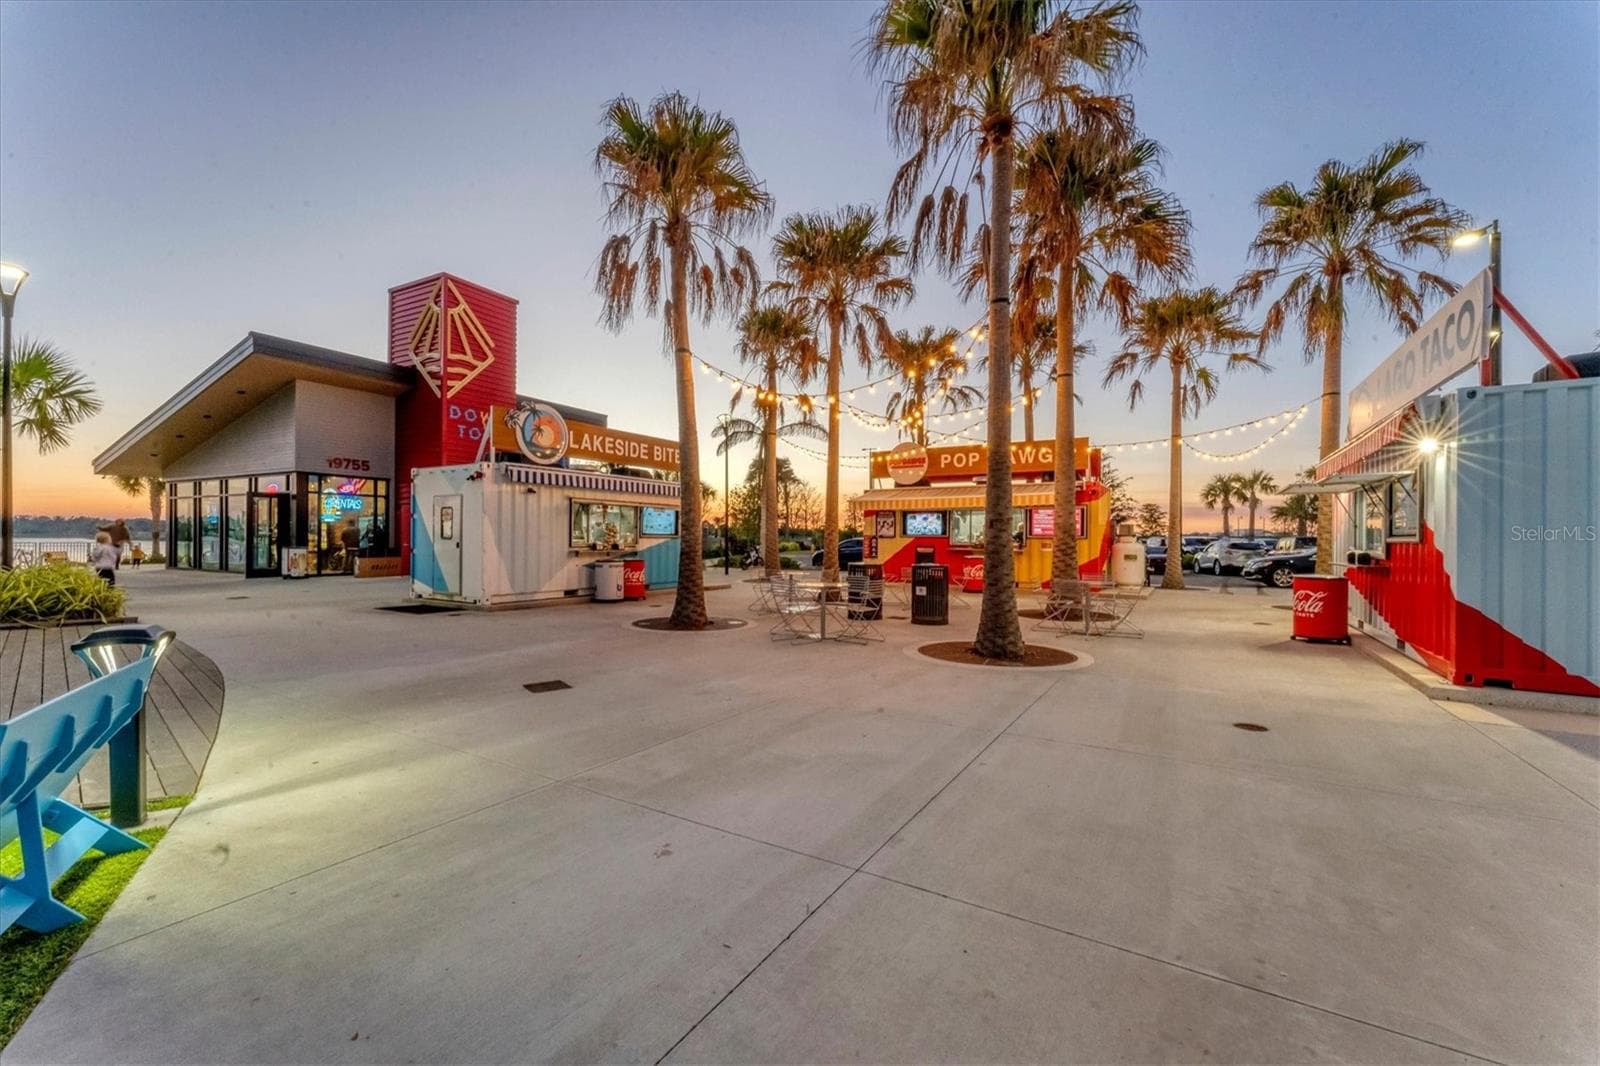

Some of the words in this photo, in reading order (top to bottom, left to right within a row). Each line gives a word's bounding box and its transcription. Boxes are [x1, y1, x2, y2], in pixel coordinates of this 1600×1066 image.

[1421, 300, 1475, 378] TACO
[569, 430, 649, 460] LAKESIDE
[327, 457, 371, 471] 19755
[940, 452, 980, 469] POP
[1294, 590, 1328, 613] Cola
